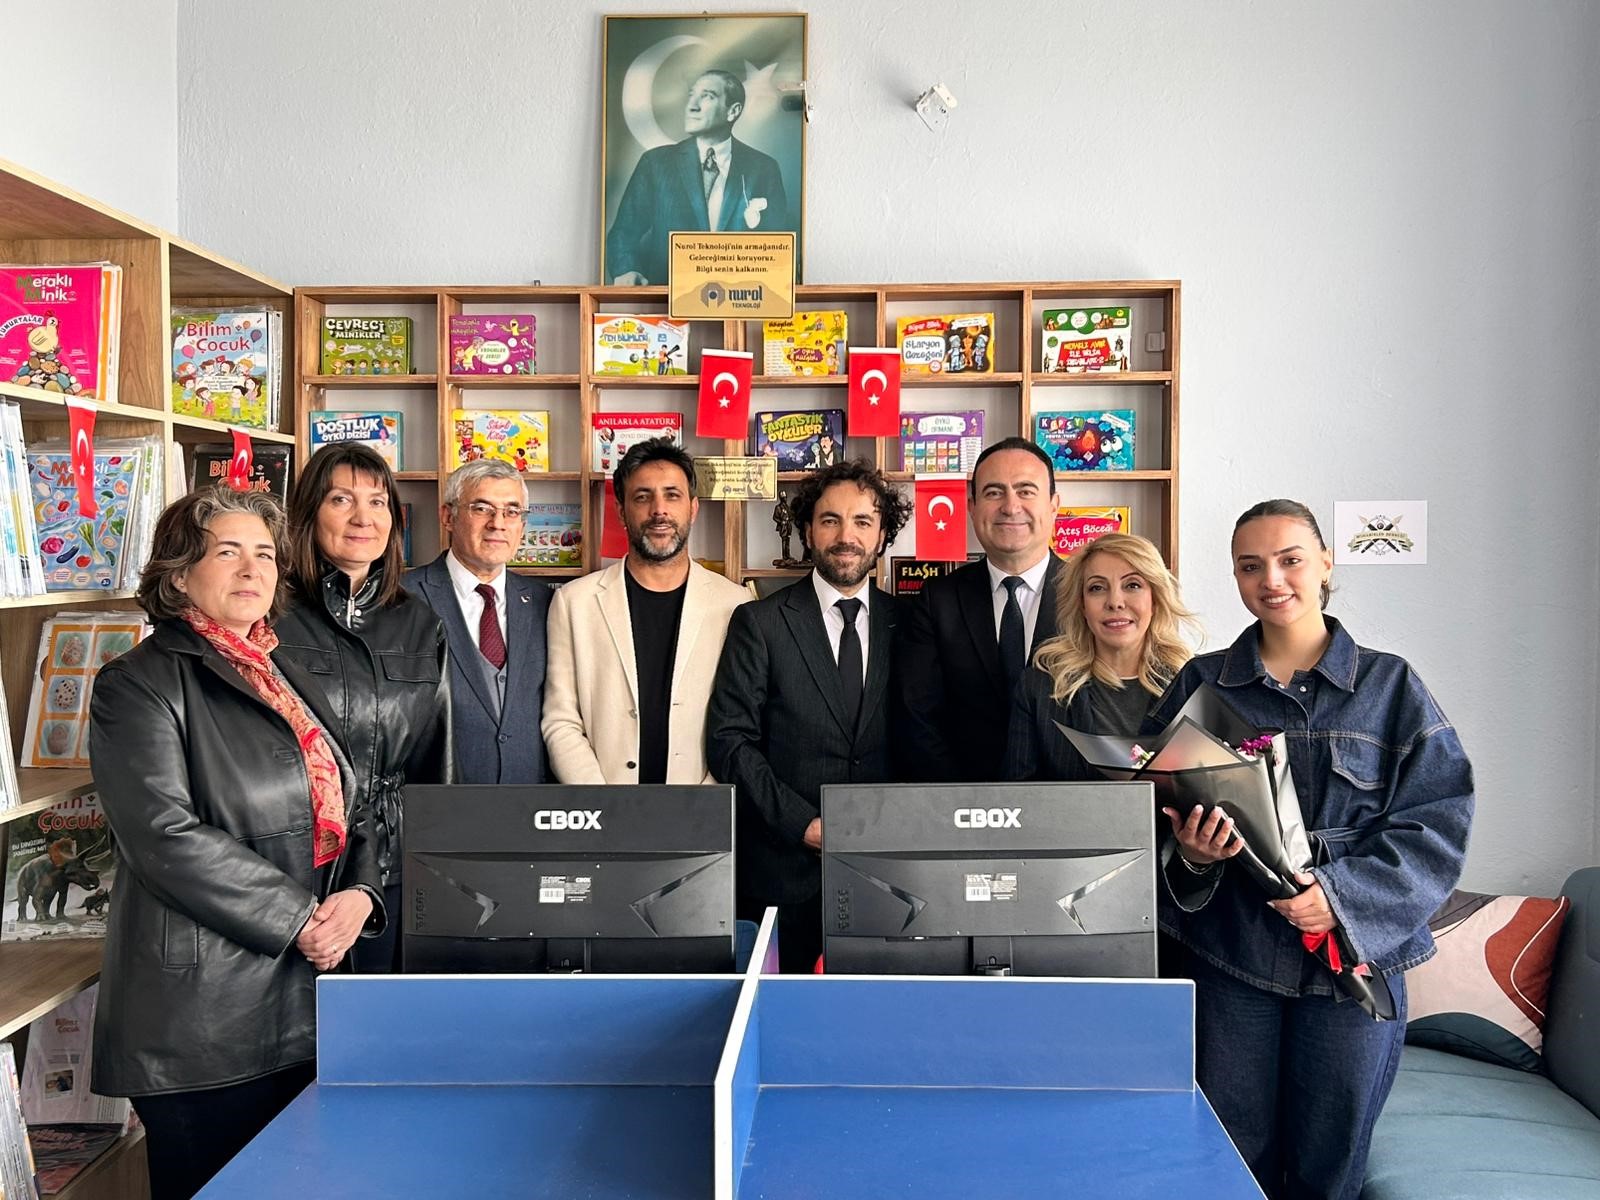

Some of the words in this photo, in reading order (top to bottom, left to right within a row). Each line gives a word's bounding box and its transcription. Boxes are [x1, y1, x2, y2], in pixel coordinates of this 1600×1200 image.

[697, 243, 743, 252] Teknoloji'nin
[744, 243, 790, 252] armağanıdır.
[689, 254, 736, 262] Geleceğimizi
[17, 273, 72, 289] Meraklı
[25, 287, 68, 301] Minik
[728, 285, 763, 301] nurol
[187, 322, 232, 337] Bilim
[196, 336, 250, 353] Çocuk
[316, 418, 380, 435] DOSTLUK
[598, 418, 639, 426] ANILARLA
[640, 417, 676, 426] ATATÜRK
[761, 412, 823, 434] FANTASTİK
[321, 431, 345, 441] ÖYKÜ
[768, 424, 823, 442] ÖYKÜLER
[51, 460, 108, 474] Meklı
[209, 459, 255, 477] Bil
[1057, 527, 1080, 536] Ateş
[902, 563, 938, 579] FLASH
[38, 810, 104, 834] Çocuk
[534, 810, 602, 830] CBOX
[954, 808, 1022, 828] CBOX
